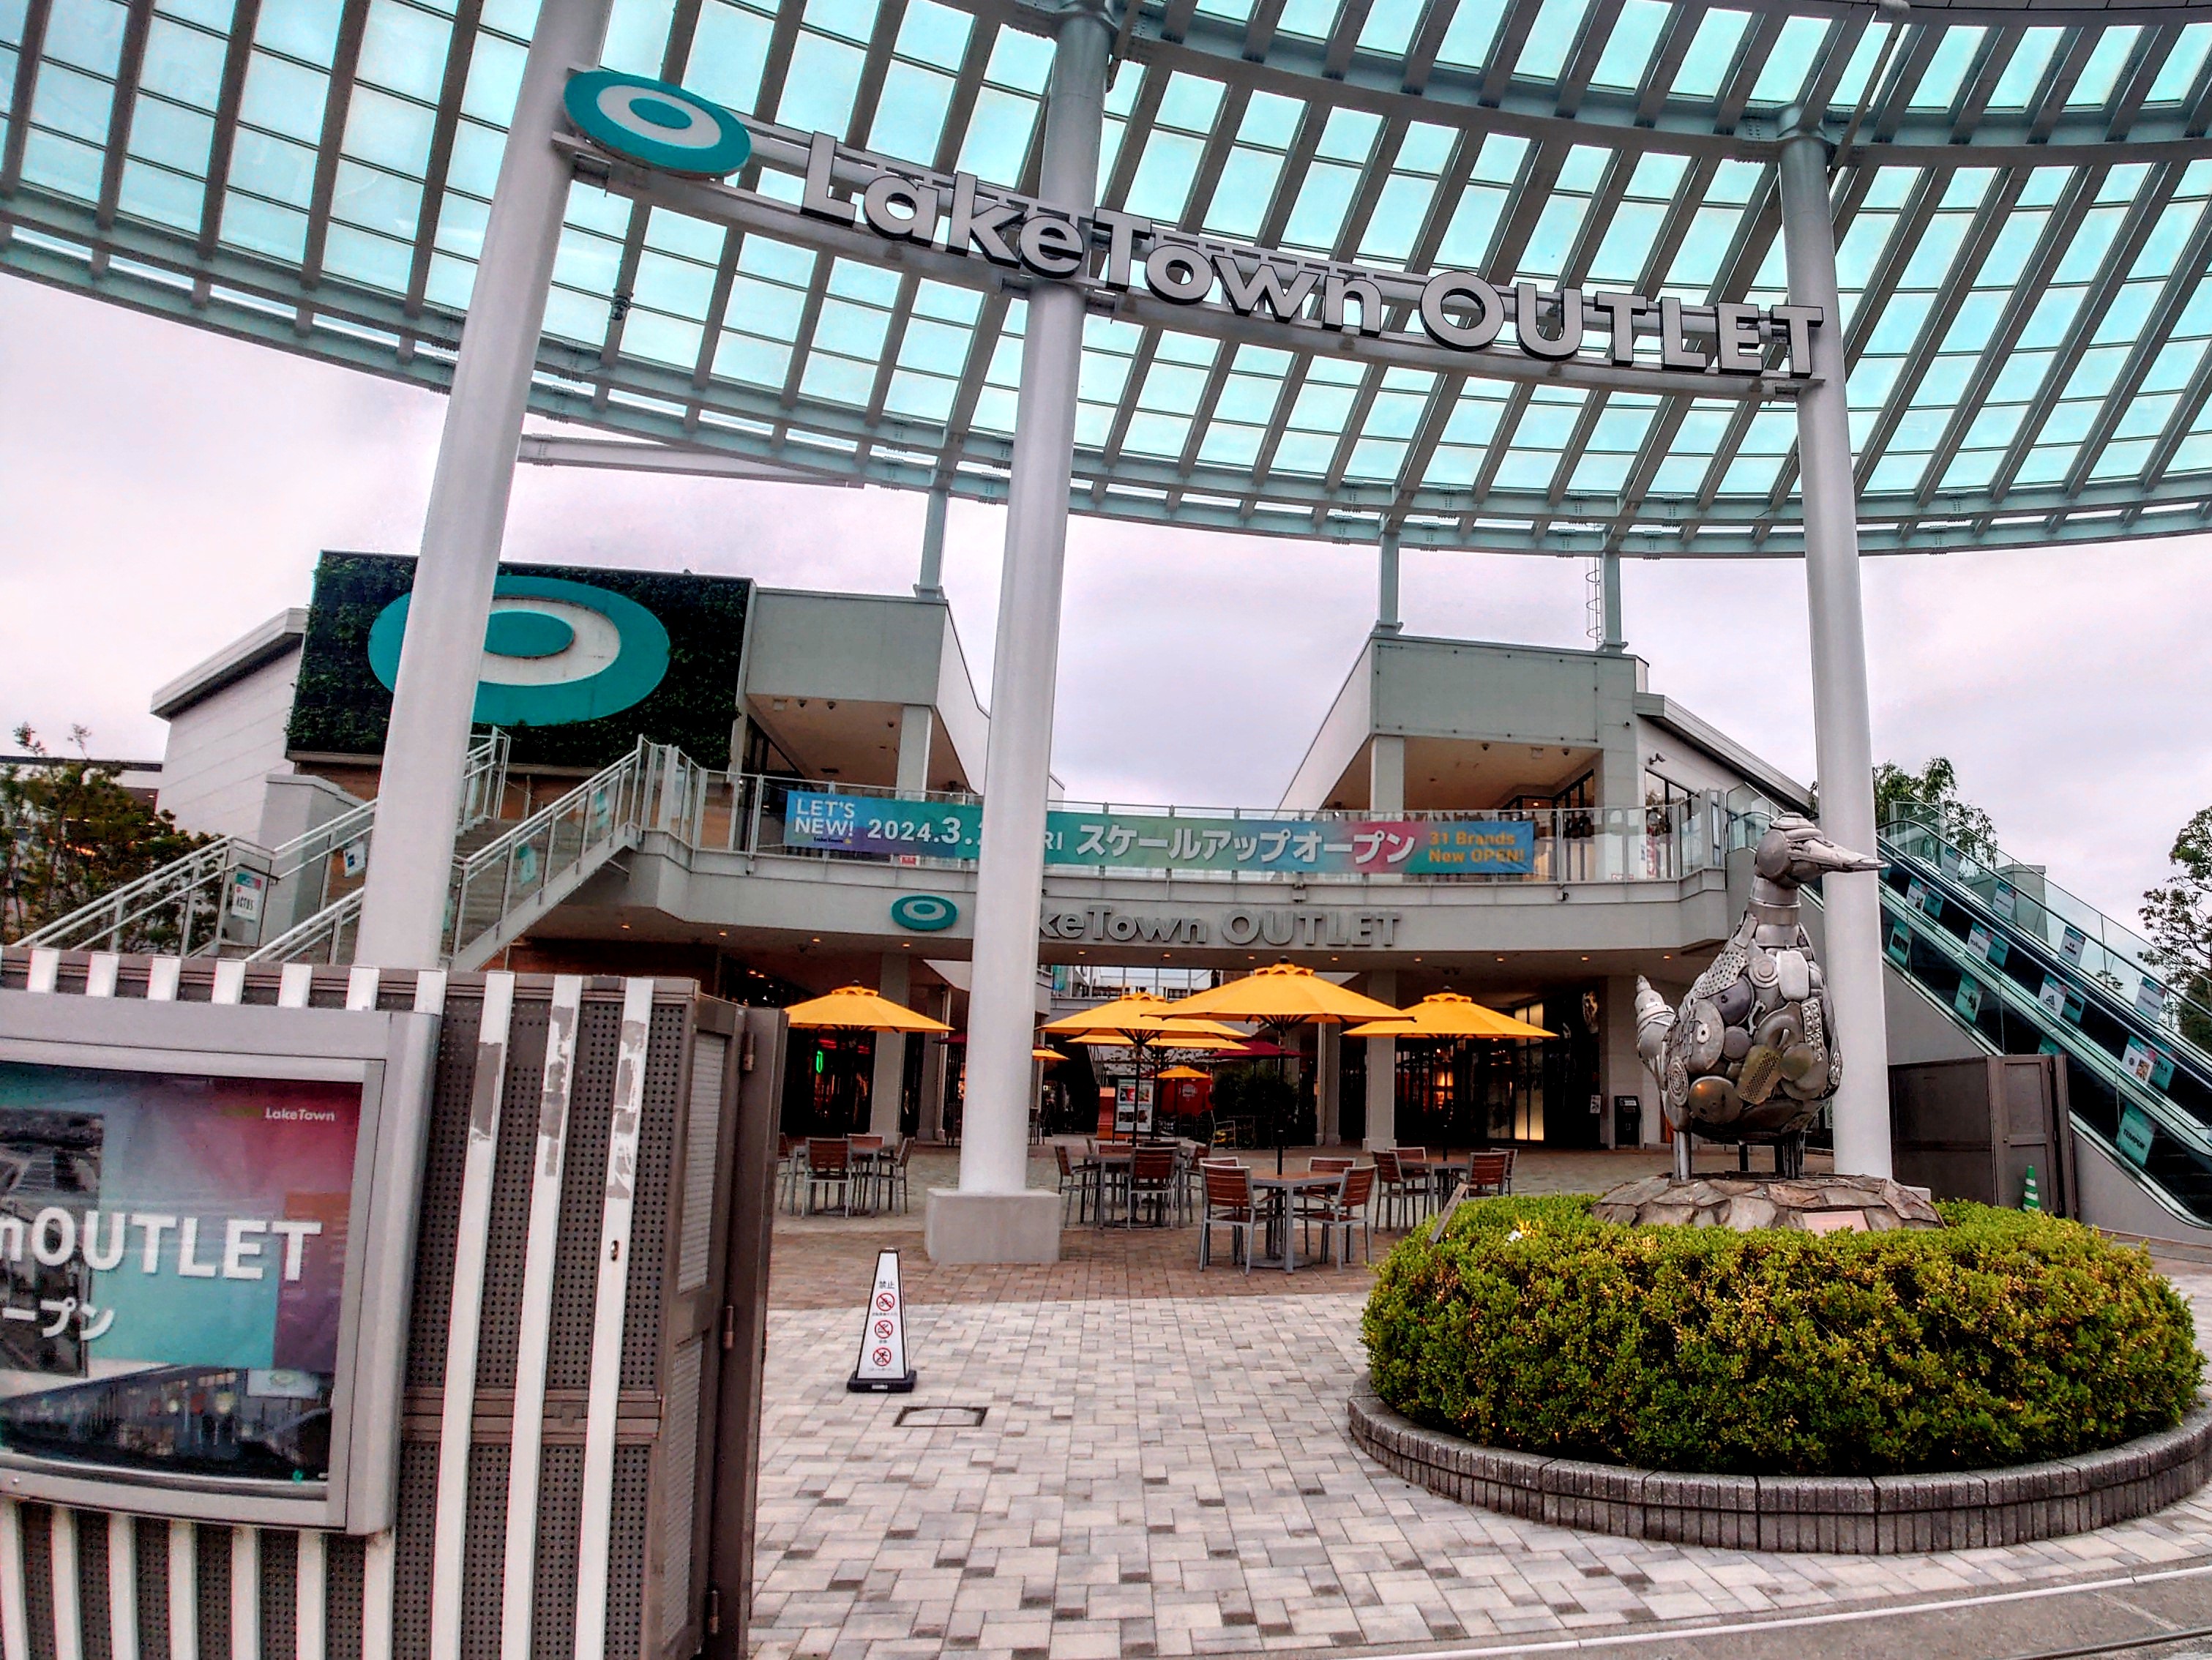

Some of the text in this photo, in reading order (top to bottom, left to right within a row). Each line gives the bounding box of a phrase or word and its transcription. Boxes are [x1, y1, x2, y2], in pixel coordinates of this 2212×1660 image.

[800, 130, 1824, 378] LakeTown OUTLET
[796, 798, 855, 819] LET'S
[794, 816, 854, 837] NEW!
[867, 816, 1063, 850] 2024.3. RI
[1076, 823, 1416, 865] スケールアップオープン
[1430, 830, 1515, 846] 31 Brands
[1471, 848, 1525, 863] OPEN!
[1039, 904, 1400, 947] keTown OUTLET
[265, 1105, 336, 1122] LakeTown
